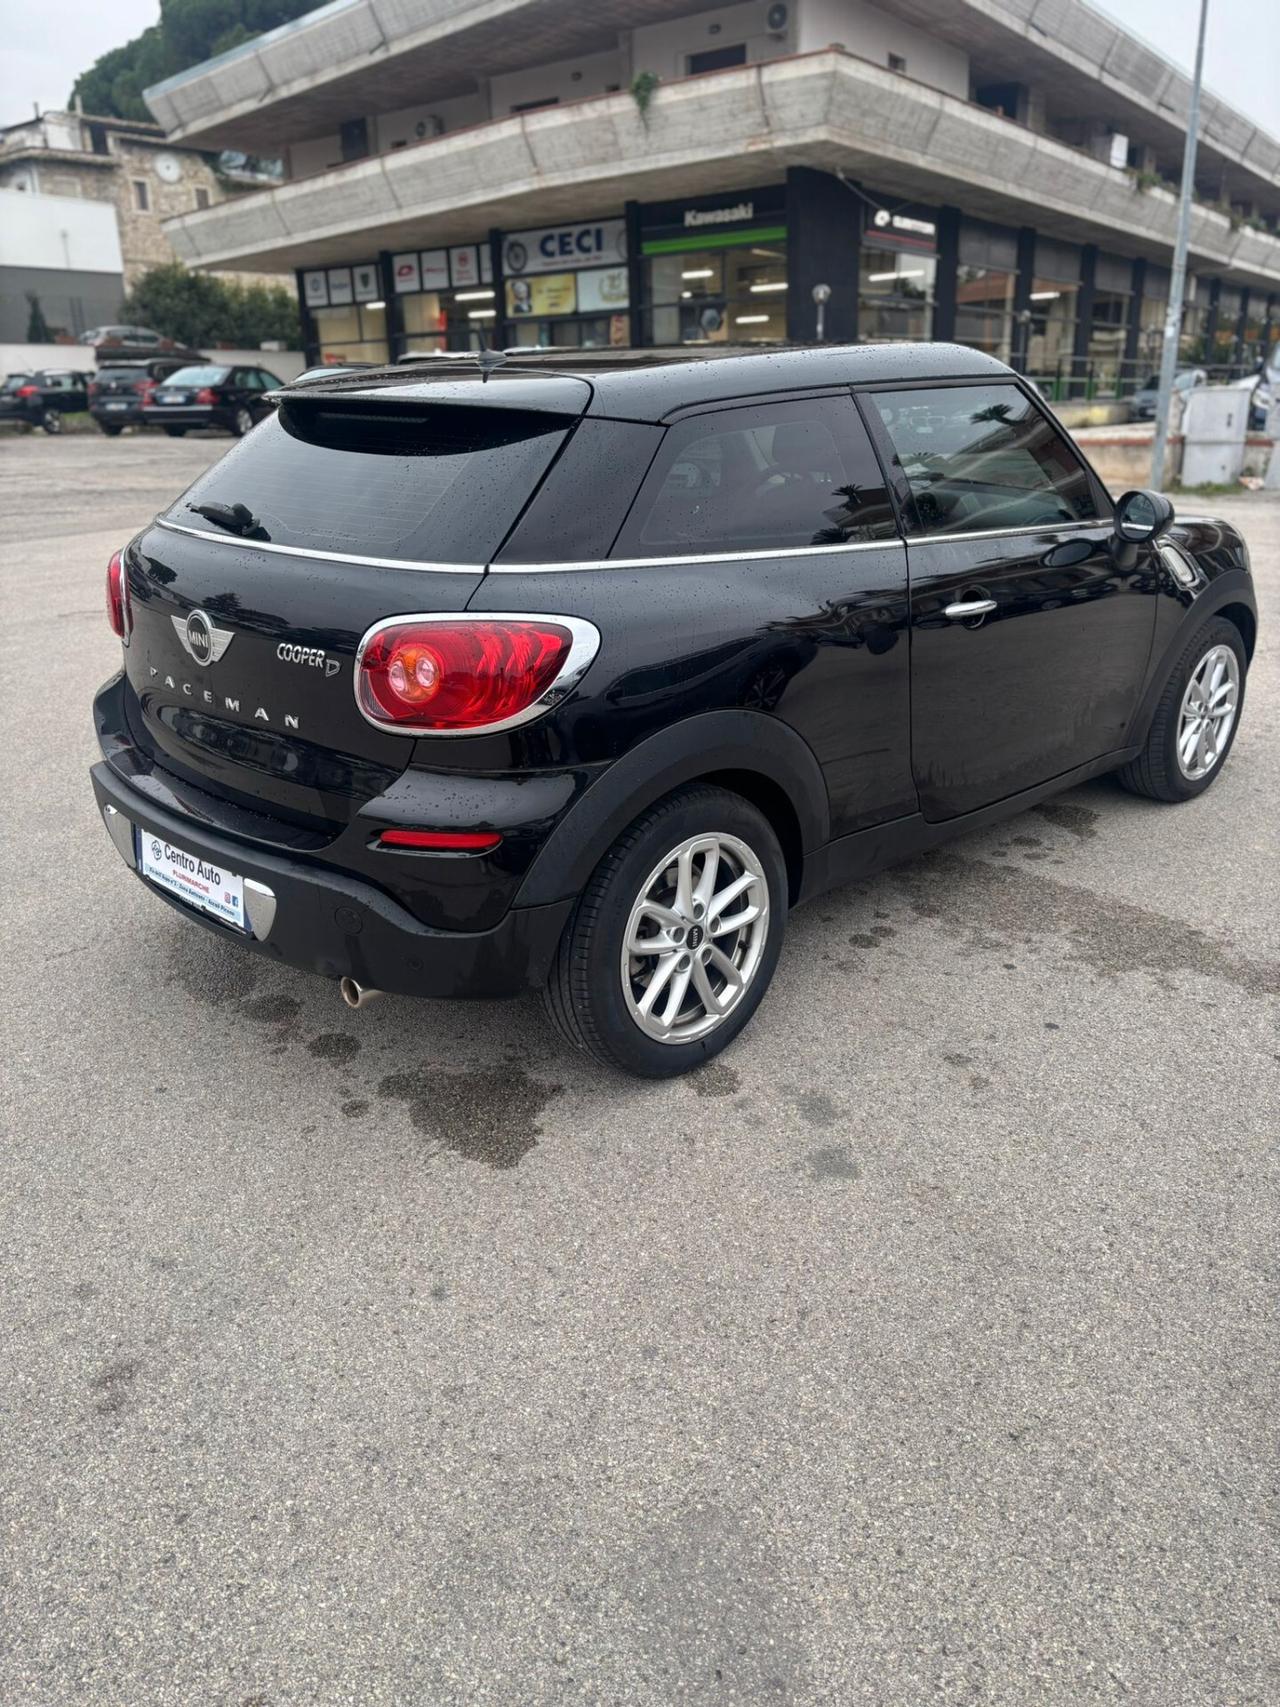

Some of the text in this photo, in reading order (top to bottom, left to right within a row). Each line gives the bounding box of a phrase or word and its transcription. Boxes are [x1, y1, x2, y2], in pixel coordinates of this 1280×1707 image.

[684, 202, 754, 227] Kawasaki
[539, 227, 604, 259] CECI
[188, 629, 209, 647] MINI
[276, 642, 341, 677] COOPER D
[149, 666, 300, 729] PACEMAN
[164, 843, 195, 873] Centro
[196, 860, 221, 886] Auto
